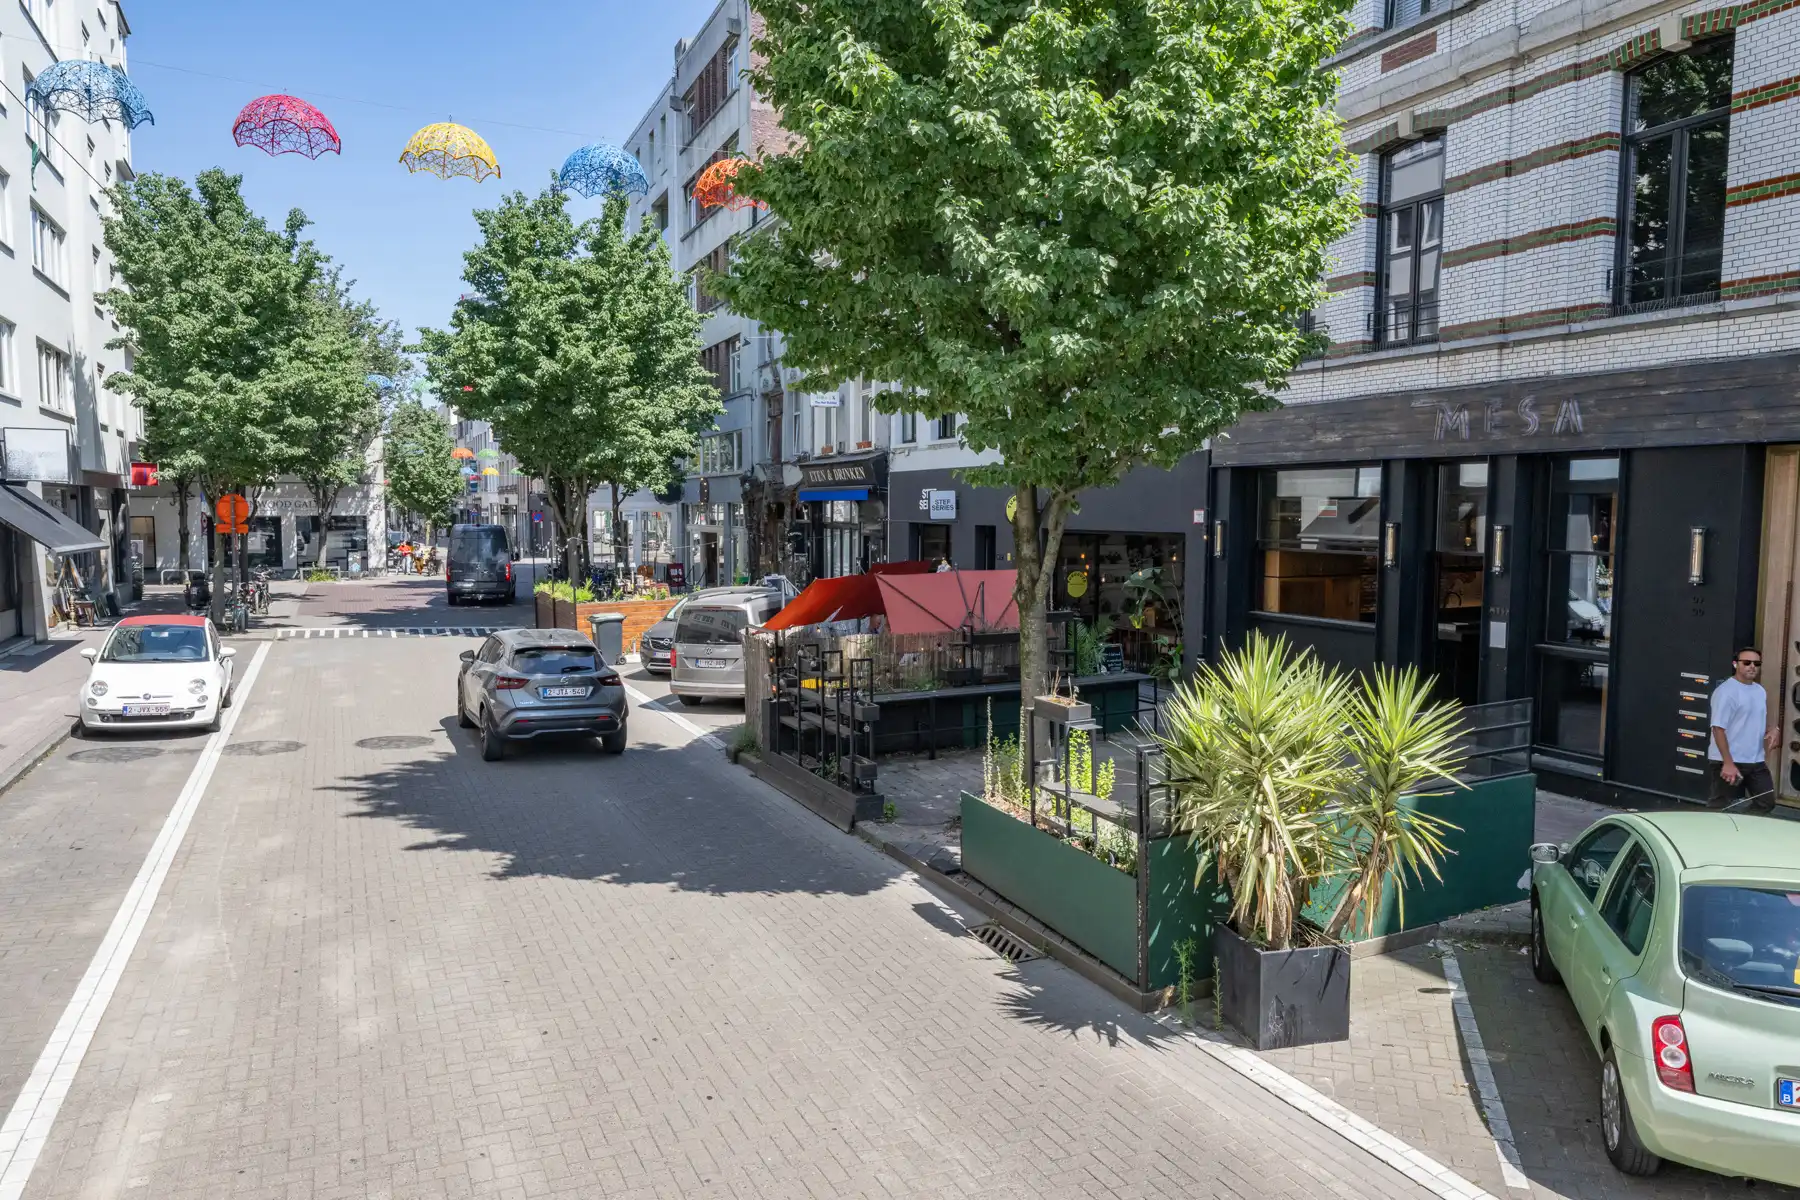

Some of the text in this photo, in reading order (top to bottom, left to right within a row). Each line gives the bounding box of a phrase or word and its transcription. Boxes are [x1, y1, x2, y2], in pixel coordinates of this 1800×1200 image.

[1410, 395, 1584, 441] MESA
[808, 466, 866, 482] ETEN & DRINKEN
[1783, 1093, 1791, 1103] B
